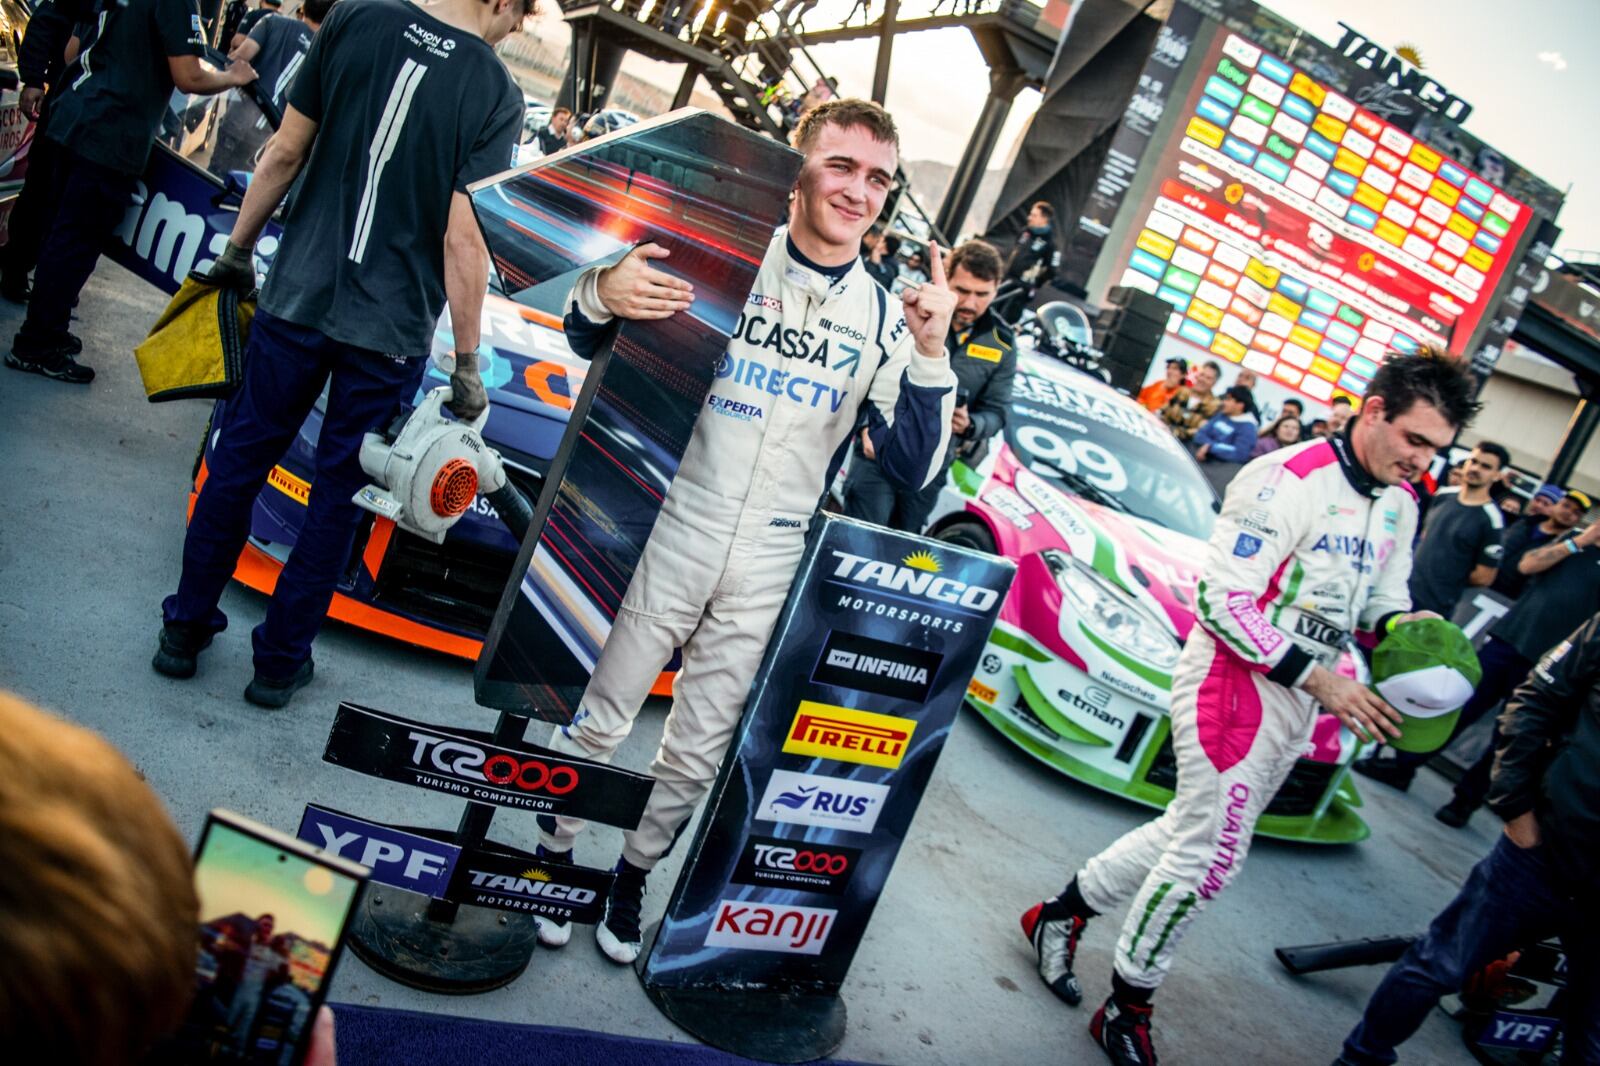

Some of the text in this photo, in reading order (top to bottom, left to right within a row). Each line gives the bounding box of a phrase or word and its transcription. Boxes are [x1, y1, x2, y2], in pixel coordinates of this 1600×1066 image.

[409, 23, 442, 46] AXION
[1337, 21, 1474, 124] TANGO
[716, 352, 848, 414] DIRECTV
[708, 395, 763, 419] EXPERTA
[460, 434, 482, 453] STIHL
[1016, 425, 1128, 492] 99
[271, 467, 312, 499] PIRELL
[832, 551, 999, 612] TANGO
[838, 595, 963, 633] MOTORSPORTS
[833, 654, 928, 685] YPF INFINIA
[1058, 688, 1125, 730] etman
[791, 714, 908, 757] PIRELLI
[408, 732, 579, 794] TC2000
[416, 775, 554, 810] TURISMO COMPETICIÓN
[813, 791, 868, 817] RUS
[316, 822, 447, 881] YPF
[1197, 783, 1249, 900] QUANTIUM
[754, 844, 848, 875] TC2000
[468, 870, 597, 904] TANGO
[755, 871, 785, 883] TURISMO
[477, 895, 572, 917] MOTORSPORTS
[1493, 1019, 1552, 1042] YPF
